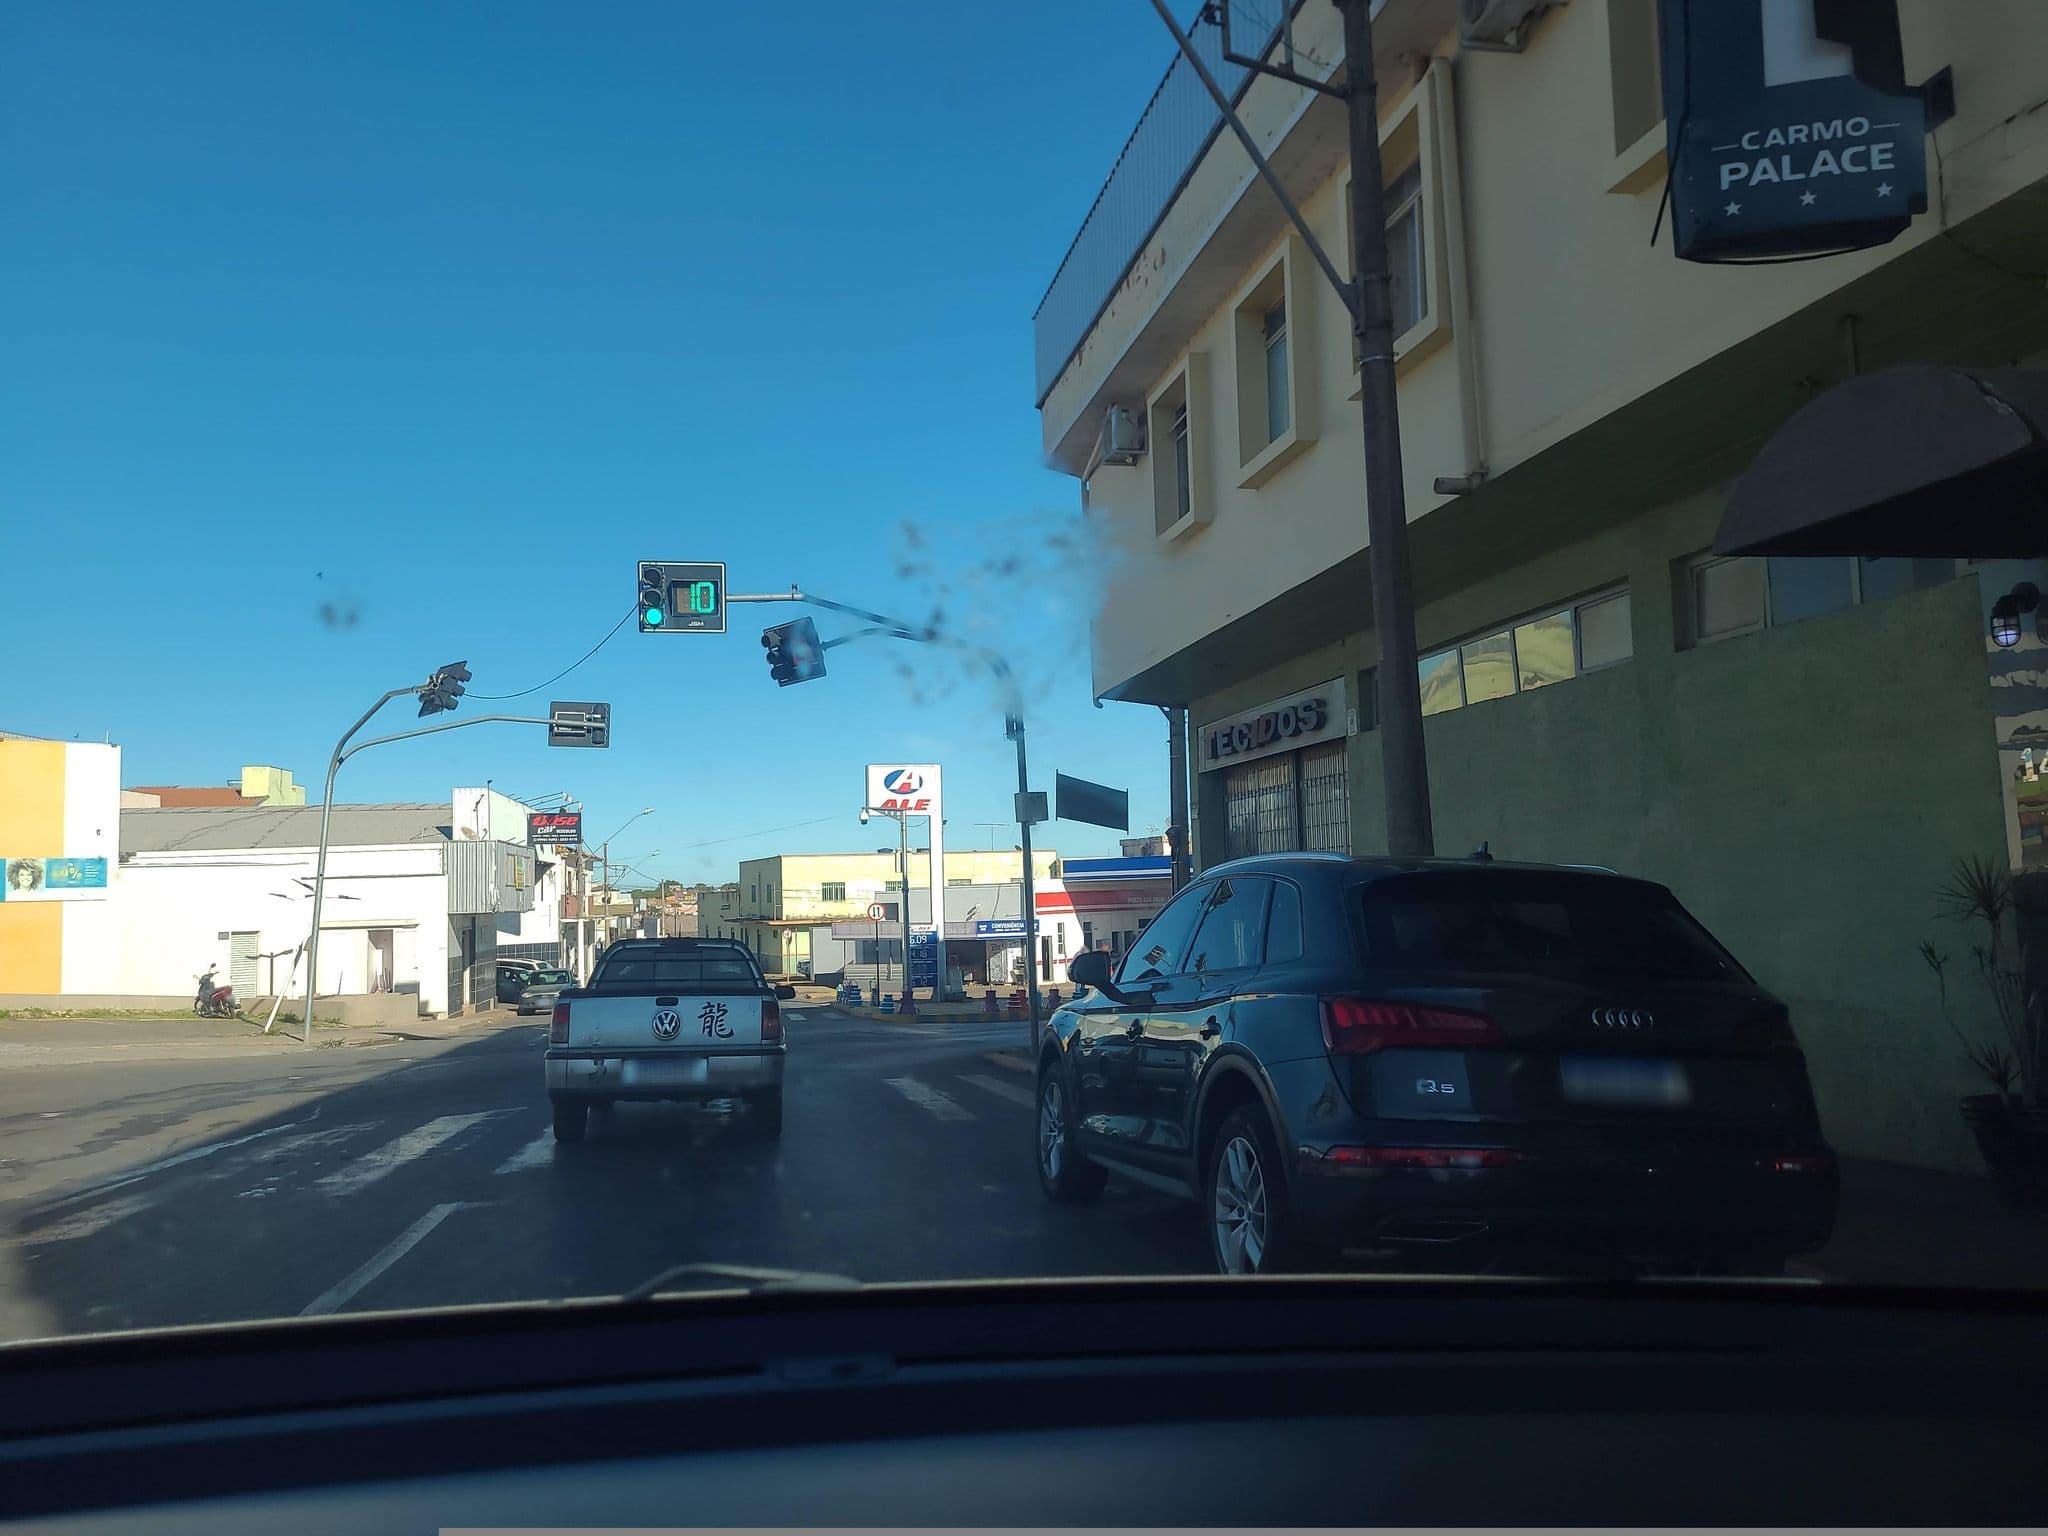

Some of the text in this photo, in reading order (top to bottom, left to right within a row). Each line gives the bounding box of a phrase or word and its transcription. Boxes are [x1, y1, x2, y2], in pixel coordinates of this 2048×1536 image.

[1741, 116, 1870, 151] CARMO
[1720, 142, 1895, 190] PALACE
[690, 581, 715, 614] 10
[1204, 698, 1326, 761] TECIDOS
[880, 799, 932, 811] ALE
[698, 1001, 735, 1039] 龍
